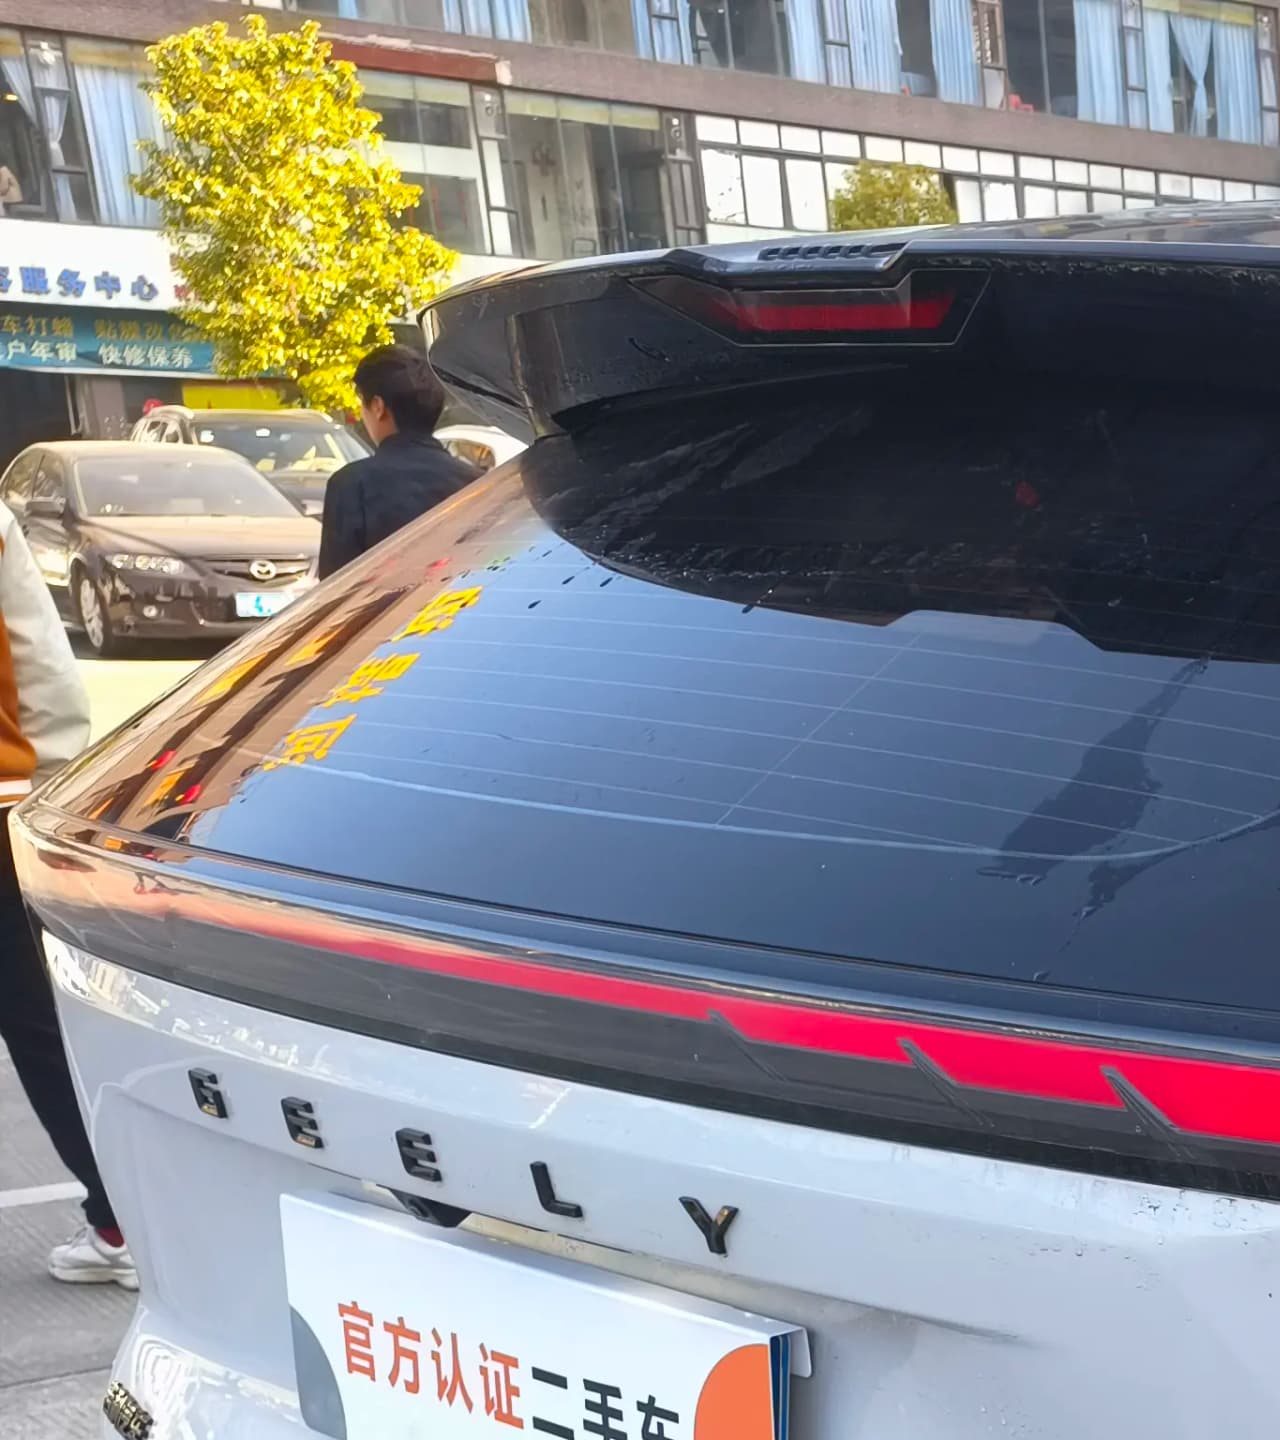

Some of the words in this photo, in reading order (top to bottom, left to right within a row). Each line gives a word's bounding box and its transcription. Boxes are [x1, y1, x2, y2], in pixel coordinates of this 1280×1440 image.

[0, 339, 77, 363] 户年审
[188, 1066, 740, 1257] GEELY
